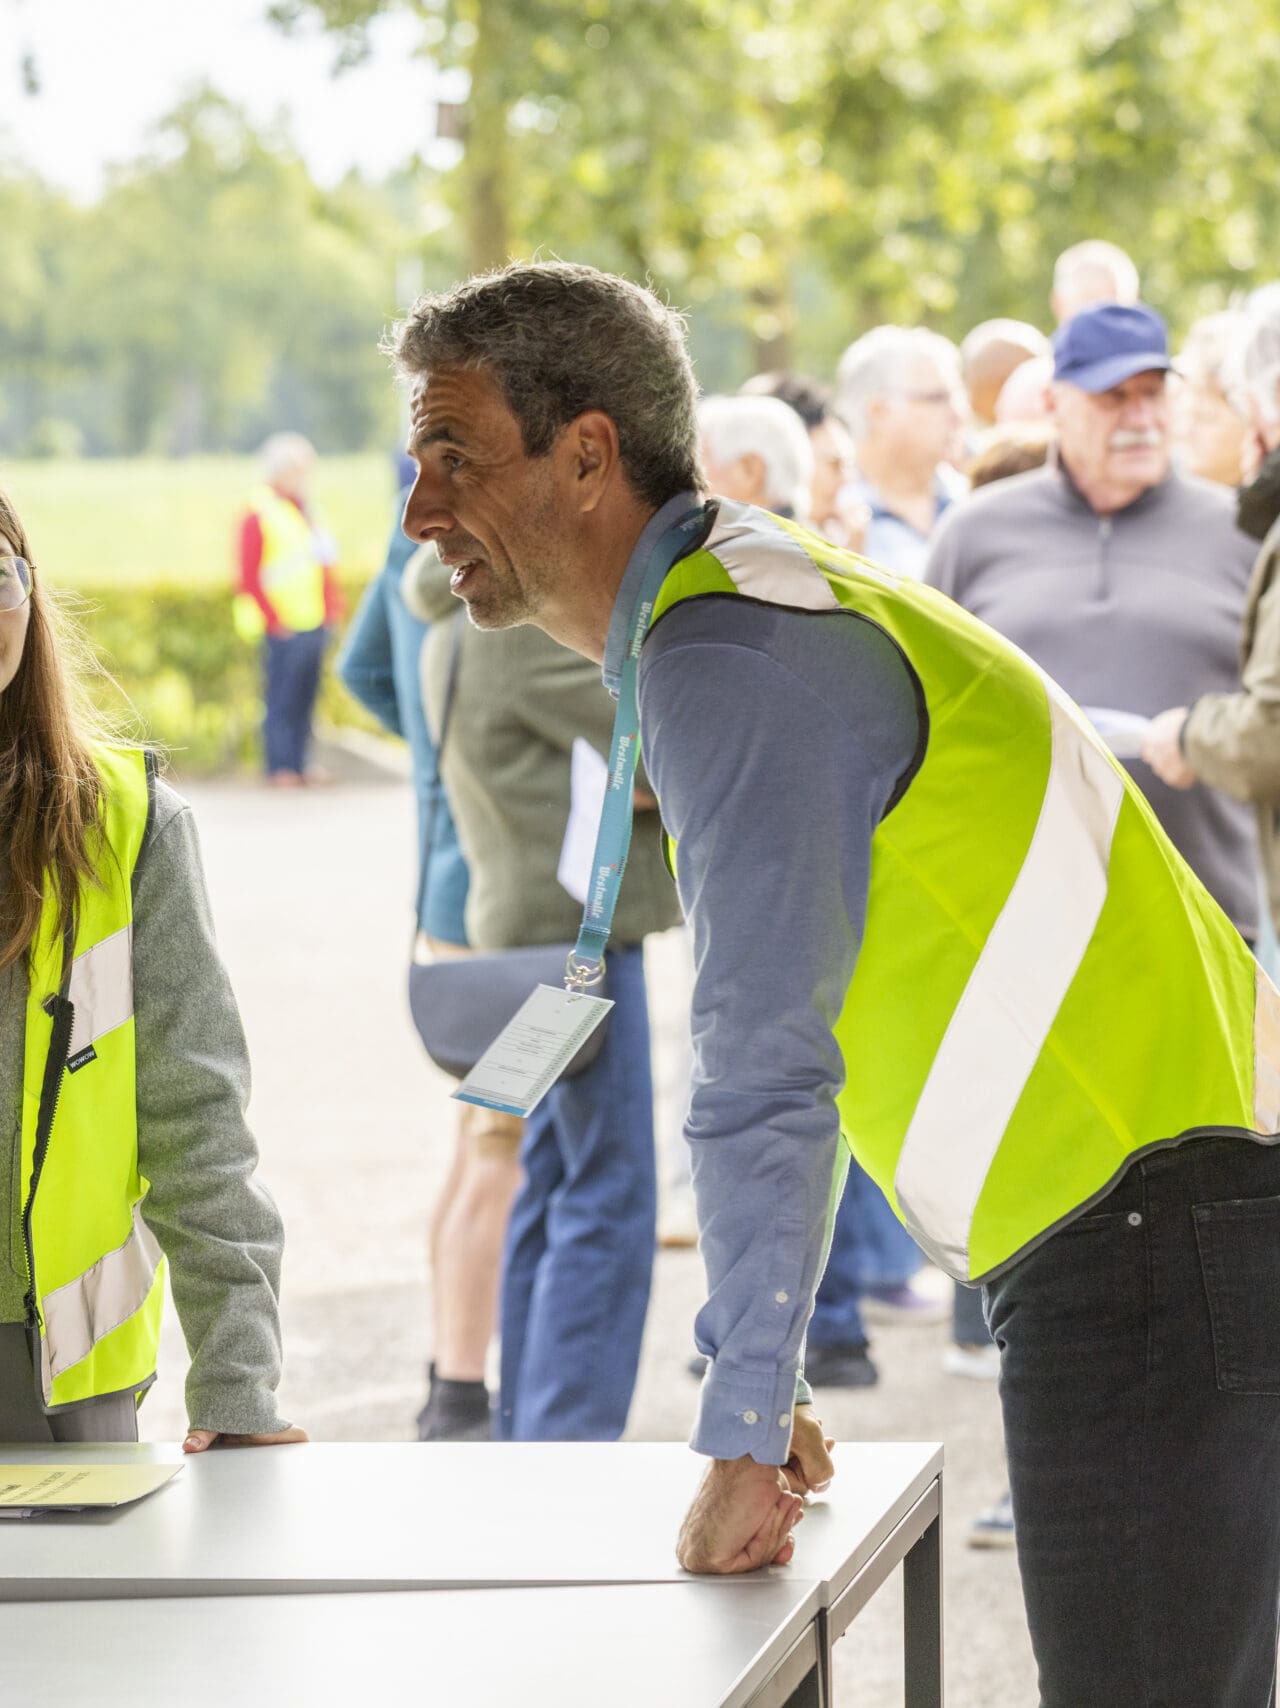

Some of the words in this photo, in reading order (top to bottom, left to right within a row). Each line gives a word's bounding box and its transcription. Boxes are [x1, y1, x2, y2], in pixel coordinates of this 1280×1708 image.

[631, 601, 652, 659] Westmalle
[613, 735, 630, 791] Westmalle
[592, 866, 610, 919] Westmalle
[70, 1050, 95, 1069] WOWOW
